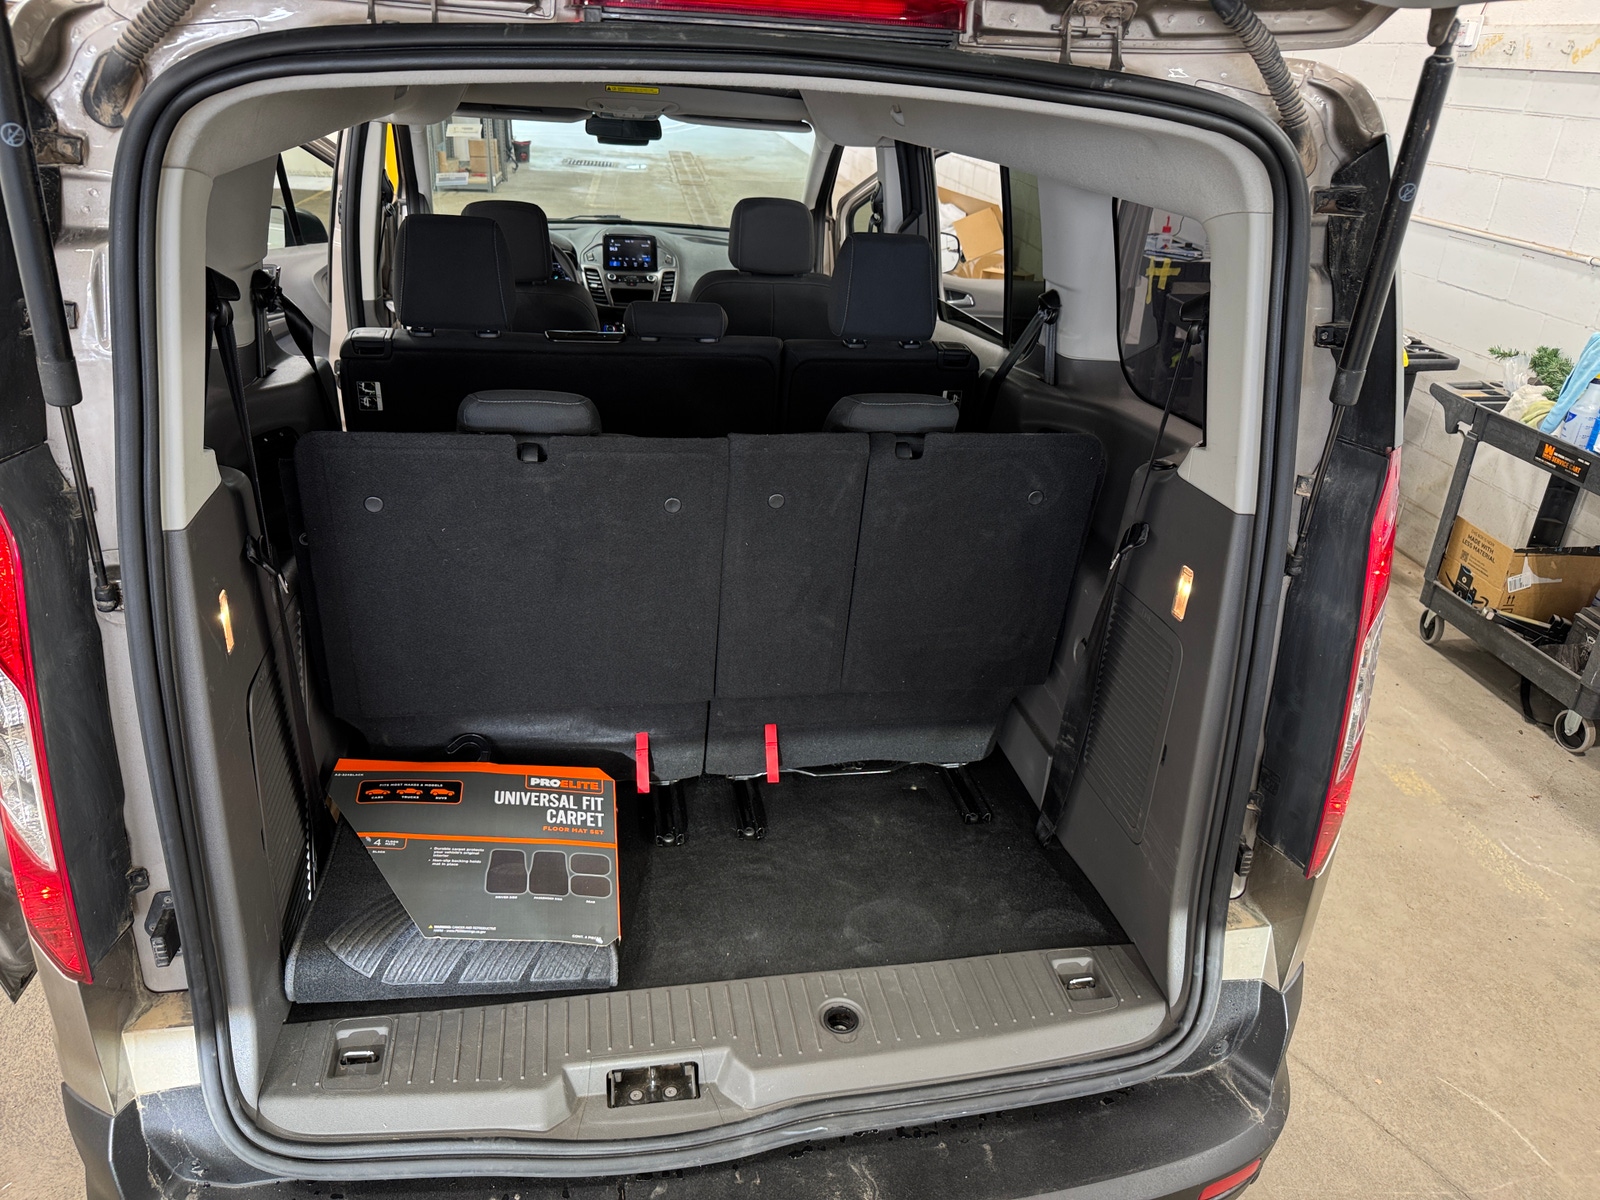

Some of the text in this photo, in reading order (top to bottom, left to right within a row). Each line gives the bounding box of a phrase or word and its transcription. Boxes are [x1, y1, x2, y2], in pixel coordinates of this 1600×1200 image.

[1551, 455, 1570, 469] SERVICE
[1569, 464, 1582, 474] CART
[1462, 538, 1496, 564] LESS MATERIAL
[1467, 534, 1495, 554] MADE WITH
[530, 777, 599, 790] PROELITE
[494, 790, 604, 811] UNIVERSAL FIT
[546, 808, 605, 828] CARPET
[373, 838, 382, 846] 4
